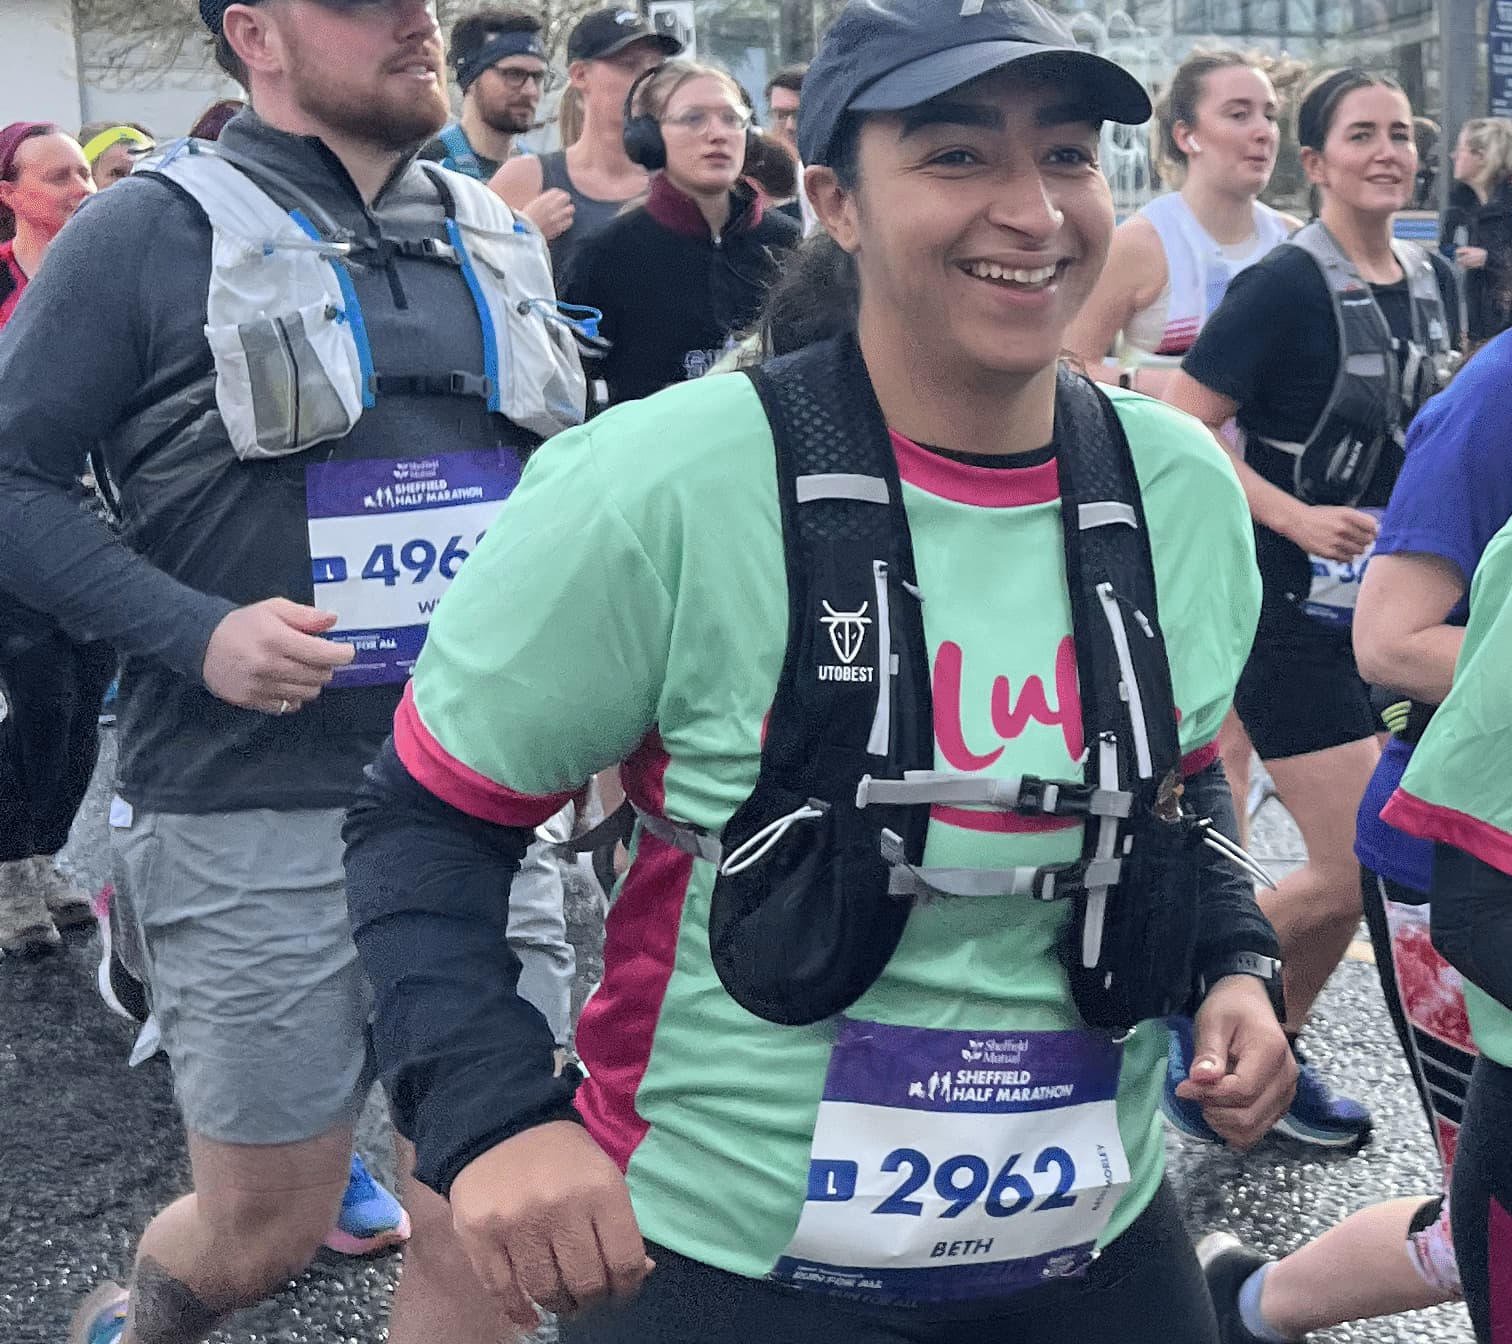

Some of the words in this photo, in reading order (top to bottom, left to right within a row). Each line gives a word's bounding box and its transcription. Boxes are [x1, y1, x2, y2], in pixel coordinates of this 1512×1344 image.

[395, 479, 447, 495] SHEFFIELD
[395, 494, 424, 506] HALF
[426, 486, 483, 503] MARATHON
[361, 529, 487, 587] 496
[818, 665, 874, 683] UTOBEST
[955, 1069, 1031, 1086] SHEFFIELD
[952, 1086, 994, 1102] HALF
[995, 1084, 1074, 1103] MARATHON
[827, 1170, 838, 1196] L
[871, 1146, 1078, 1219] 2962
[930, 1237, 994, 1258] BETH
